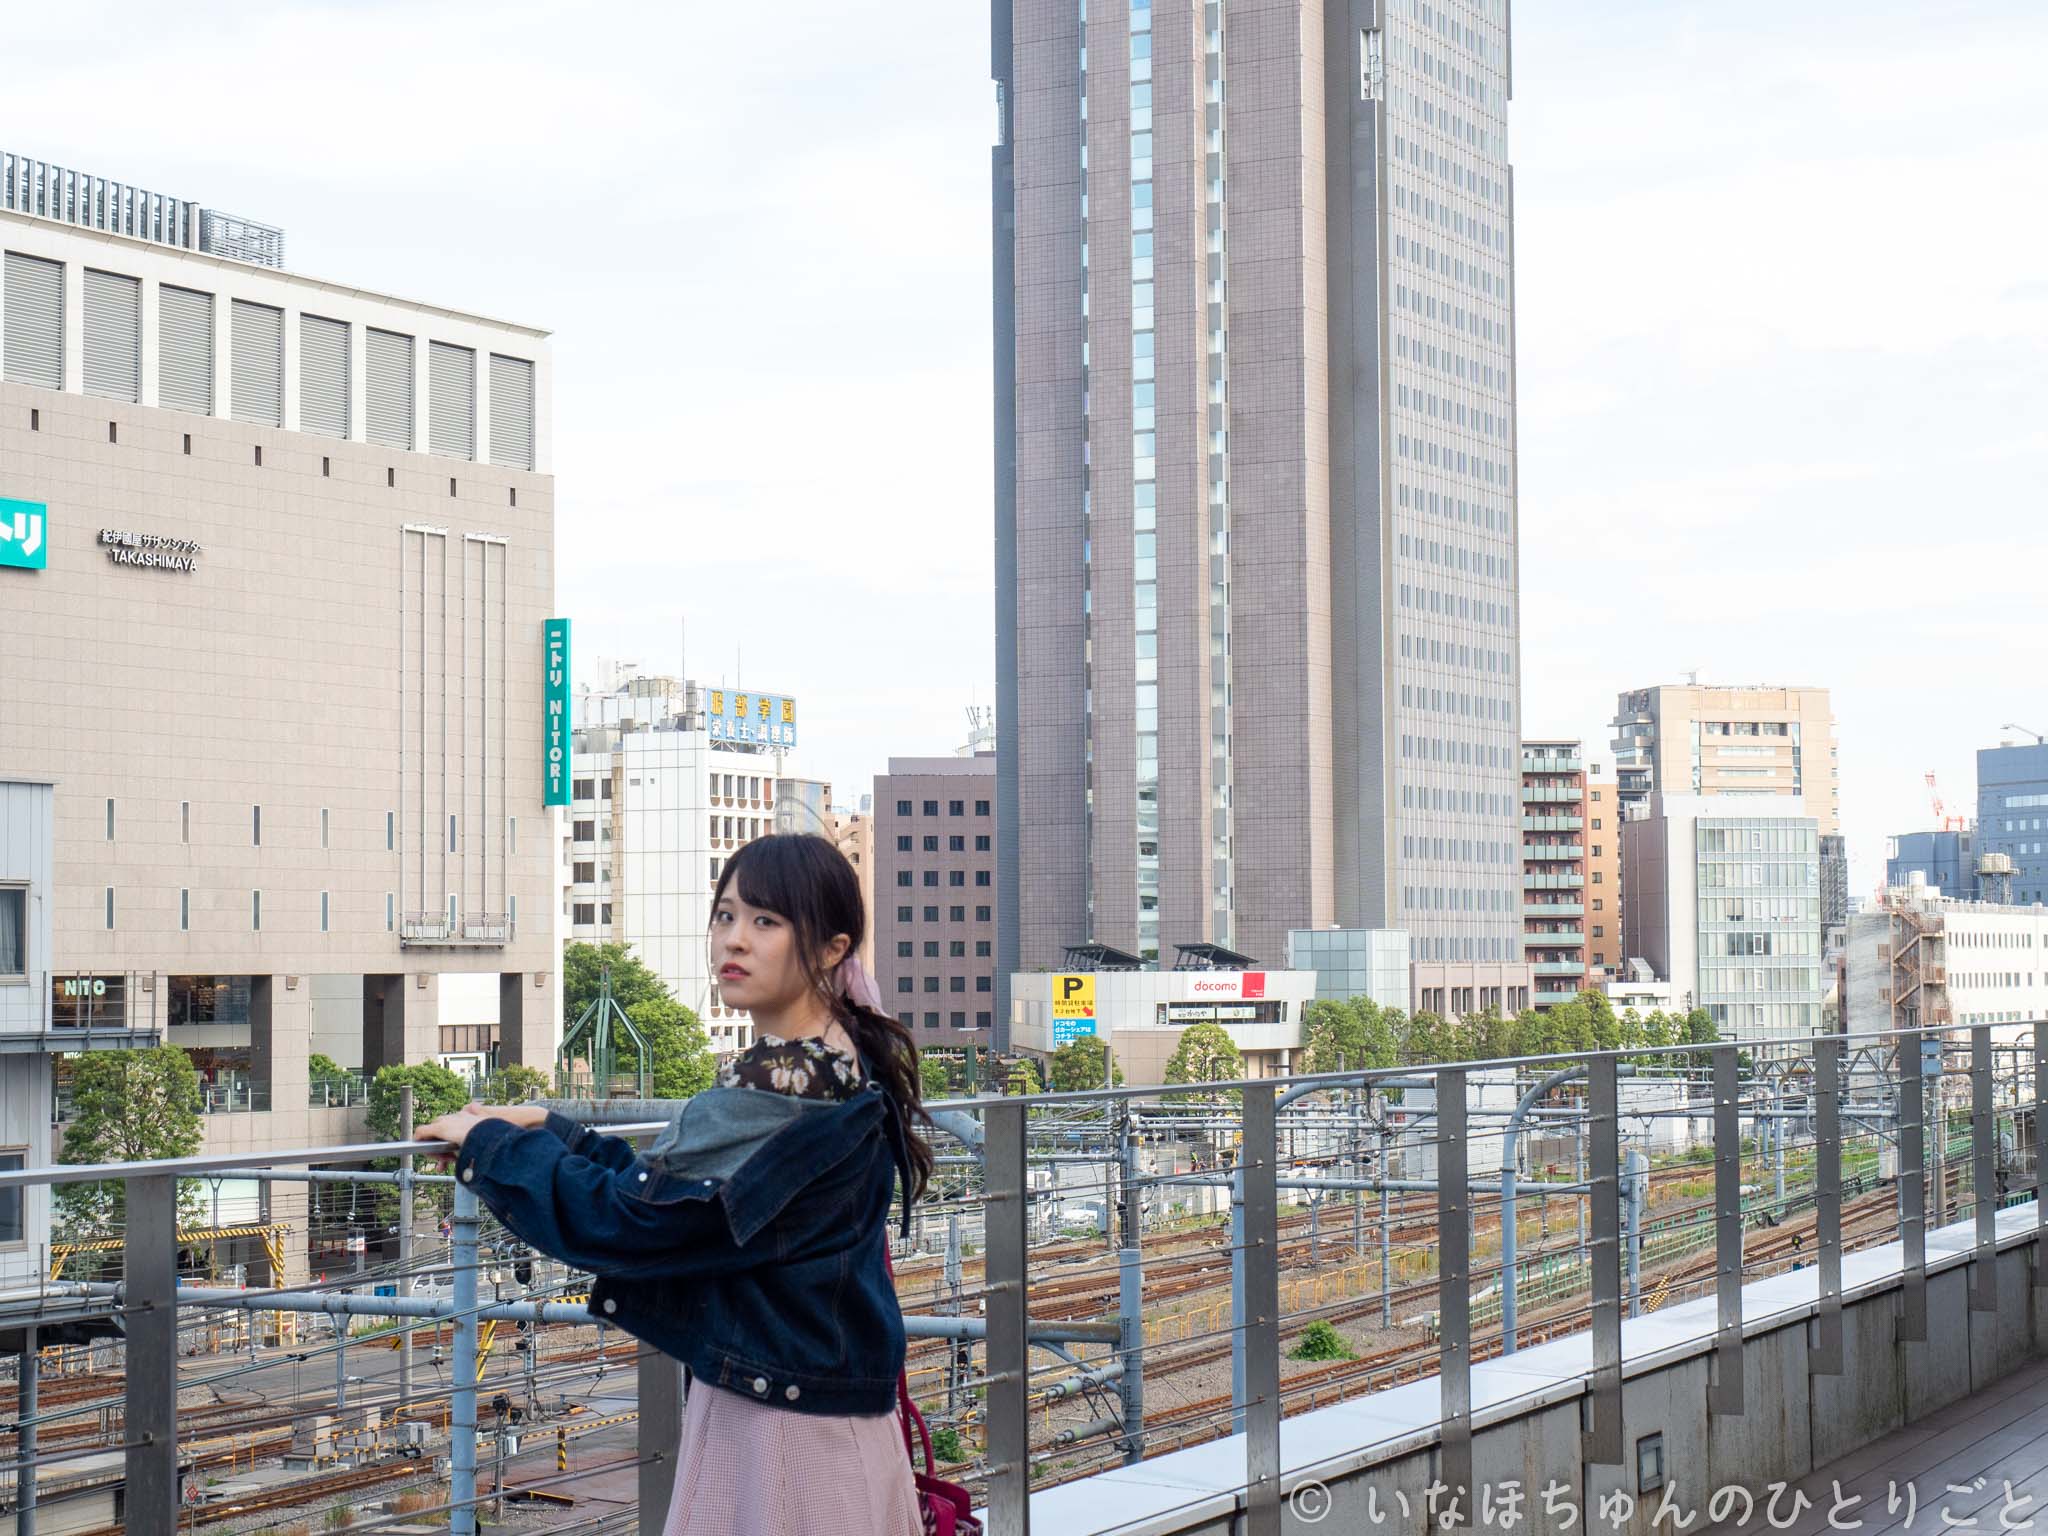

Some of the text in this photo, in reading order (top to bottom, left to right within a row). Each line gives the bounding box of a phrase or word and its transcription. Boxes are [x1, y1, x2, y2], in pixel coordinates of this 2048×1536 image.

[111, 548, 198, 571] TAKASHIMAYA
[550, 630, 562, 688] ニトリ
[550, 700, 563, 793] NITORI
[1063, 977, 1084, 1000] P
[1194, 980, 1238, 992] docomo
